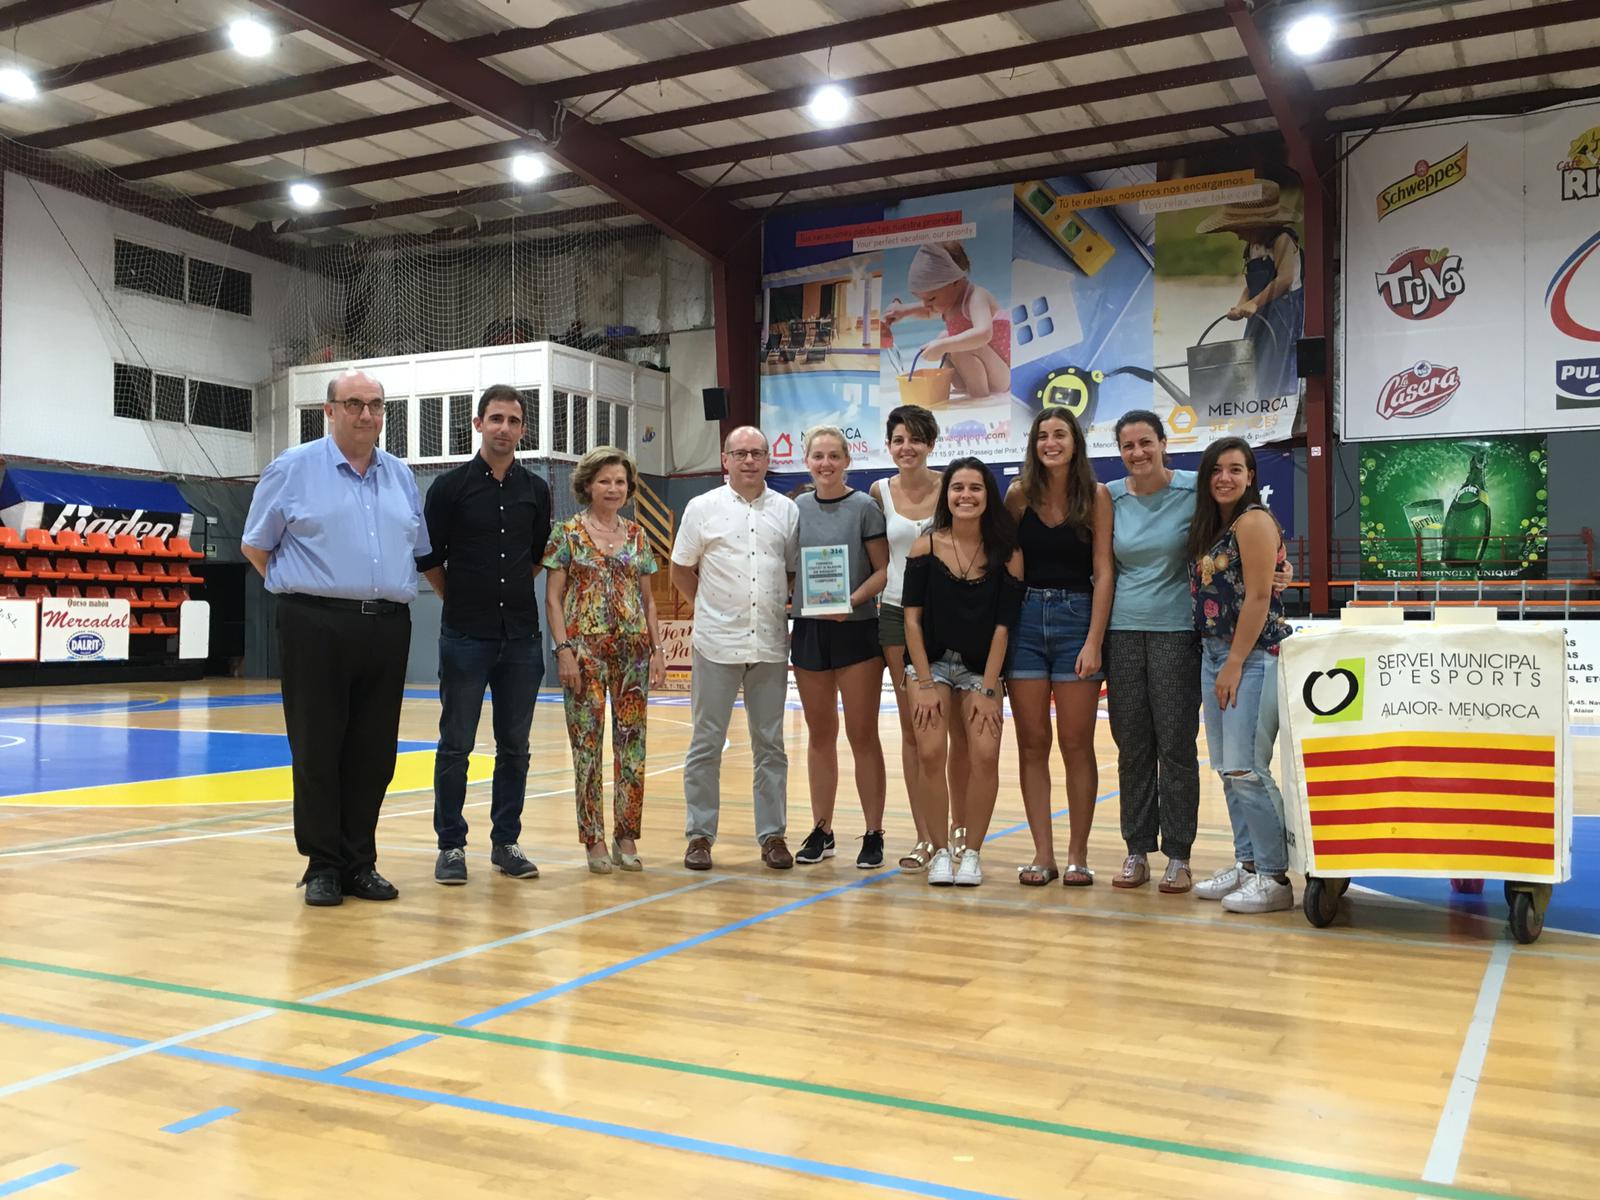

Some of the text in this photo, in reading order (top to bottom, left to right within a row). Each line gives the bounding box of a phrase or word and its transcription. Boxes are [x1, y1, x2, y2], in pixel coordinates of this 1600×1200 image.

[1118, 187, 1162, 201] nosotros
[1163, 185, 1182, 195] nos
[1381, 157, 1463, 210] Schweppes
[1561, 167, 1600, 201] RI
[856, 238, 874, 250] Your
[874, 235, 899, 249] perfect
[932, 229, 946, 240] our
[1377, 366, 1460, 420] Casera
[1208, 396, 1289, 417] MENORCA
[43, 610, 129, 628] Mercadal
[71, 639, 100, 651] DALRIT
[1377, 652, 1541, 671] SERVEI MUNICIPAL
[1585, 675, 1600, 683] ET
[1449, 701, 1541, 719] MENORCA
